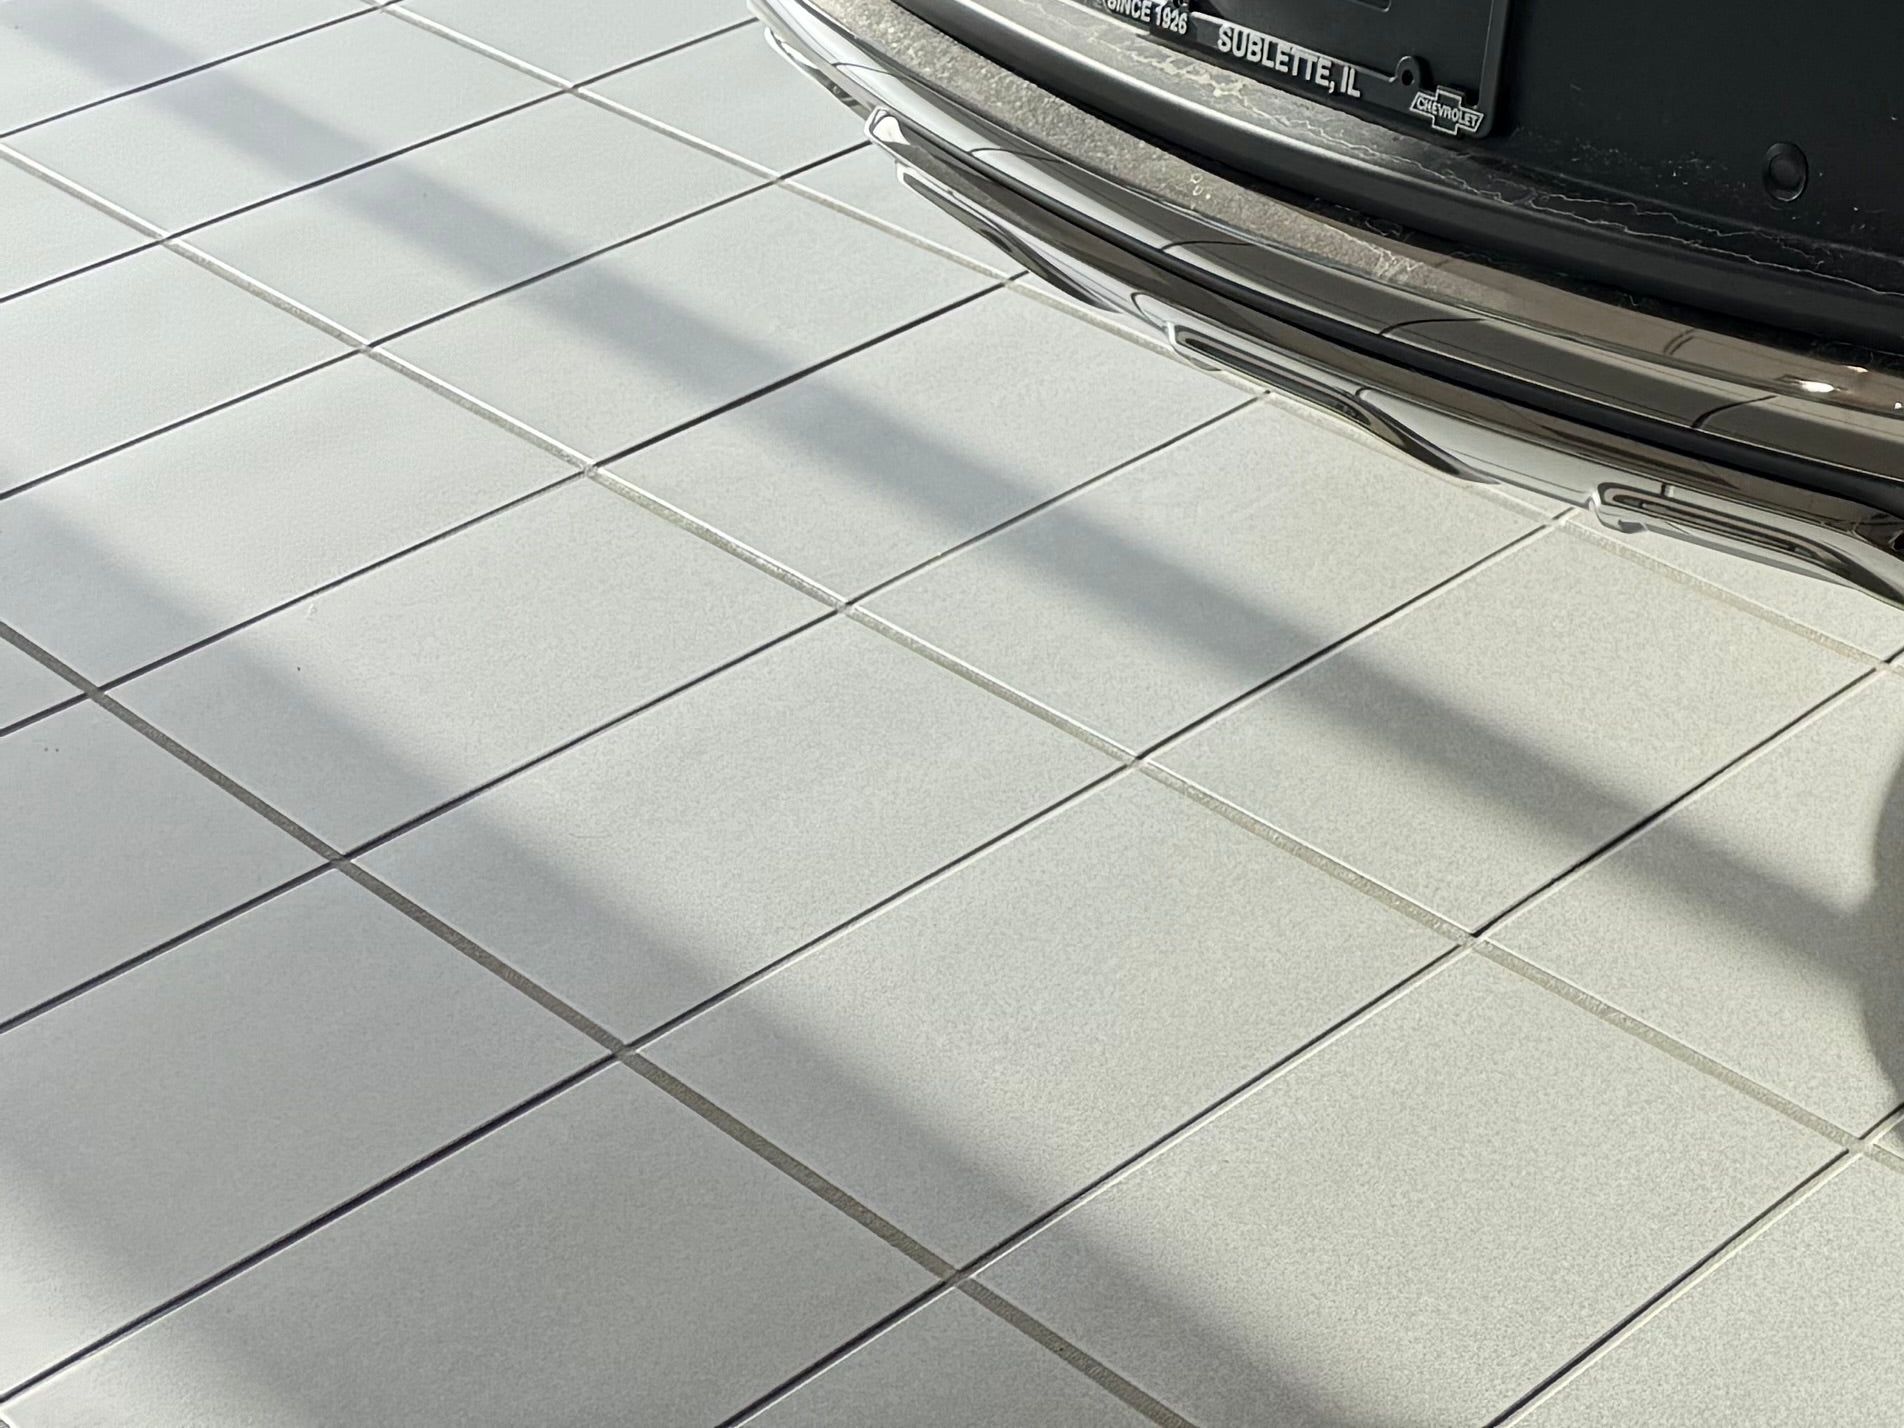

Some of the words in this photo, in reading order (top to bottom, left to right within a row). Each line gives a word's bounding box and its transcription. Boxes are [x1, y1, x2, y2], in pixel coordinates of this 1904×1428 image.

[1154, 6, 1188, 35] 1926
[1217, 24, 1335, 94] SUBLETTE,
[1339, 66, 1361, 98] IL
[1416, 98, 1478, 127] CHEVROLET
